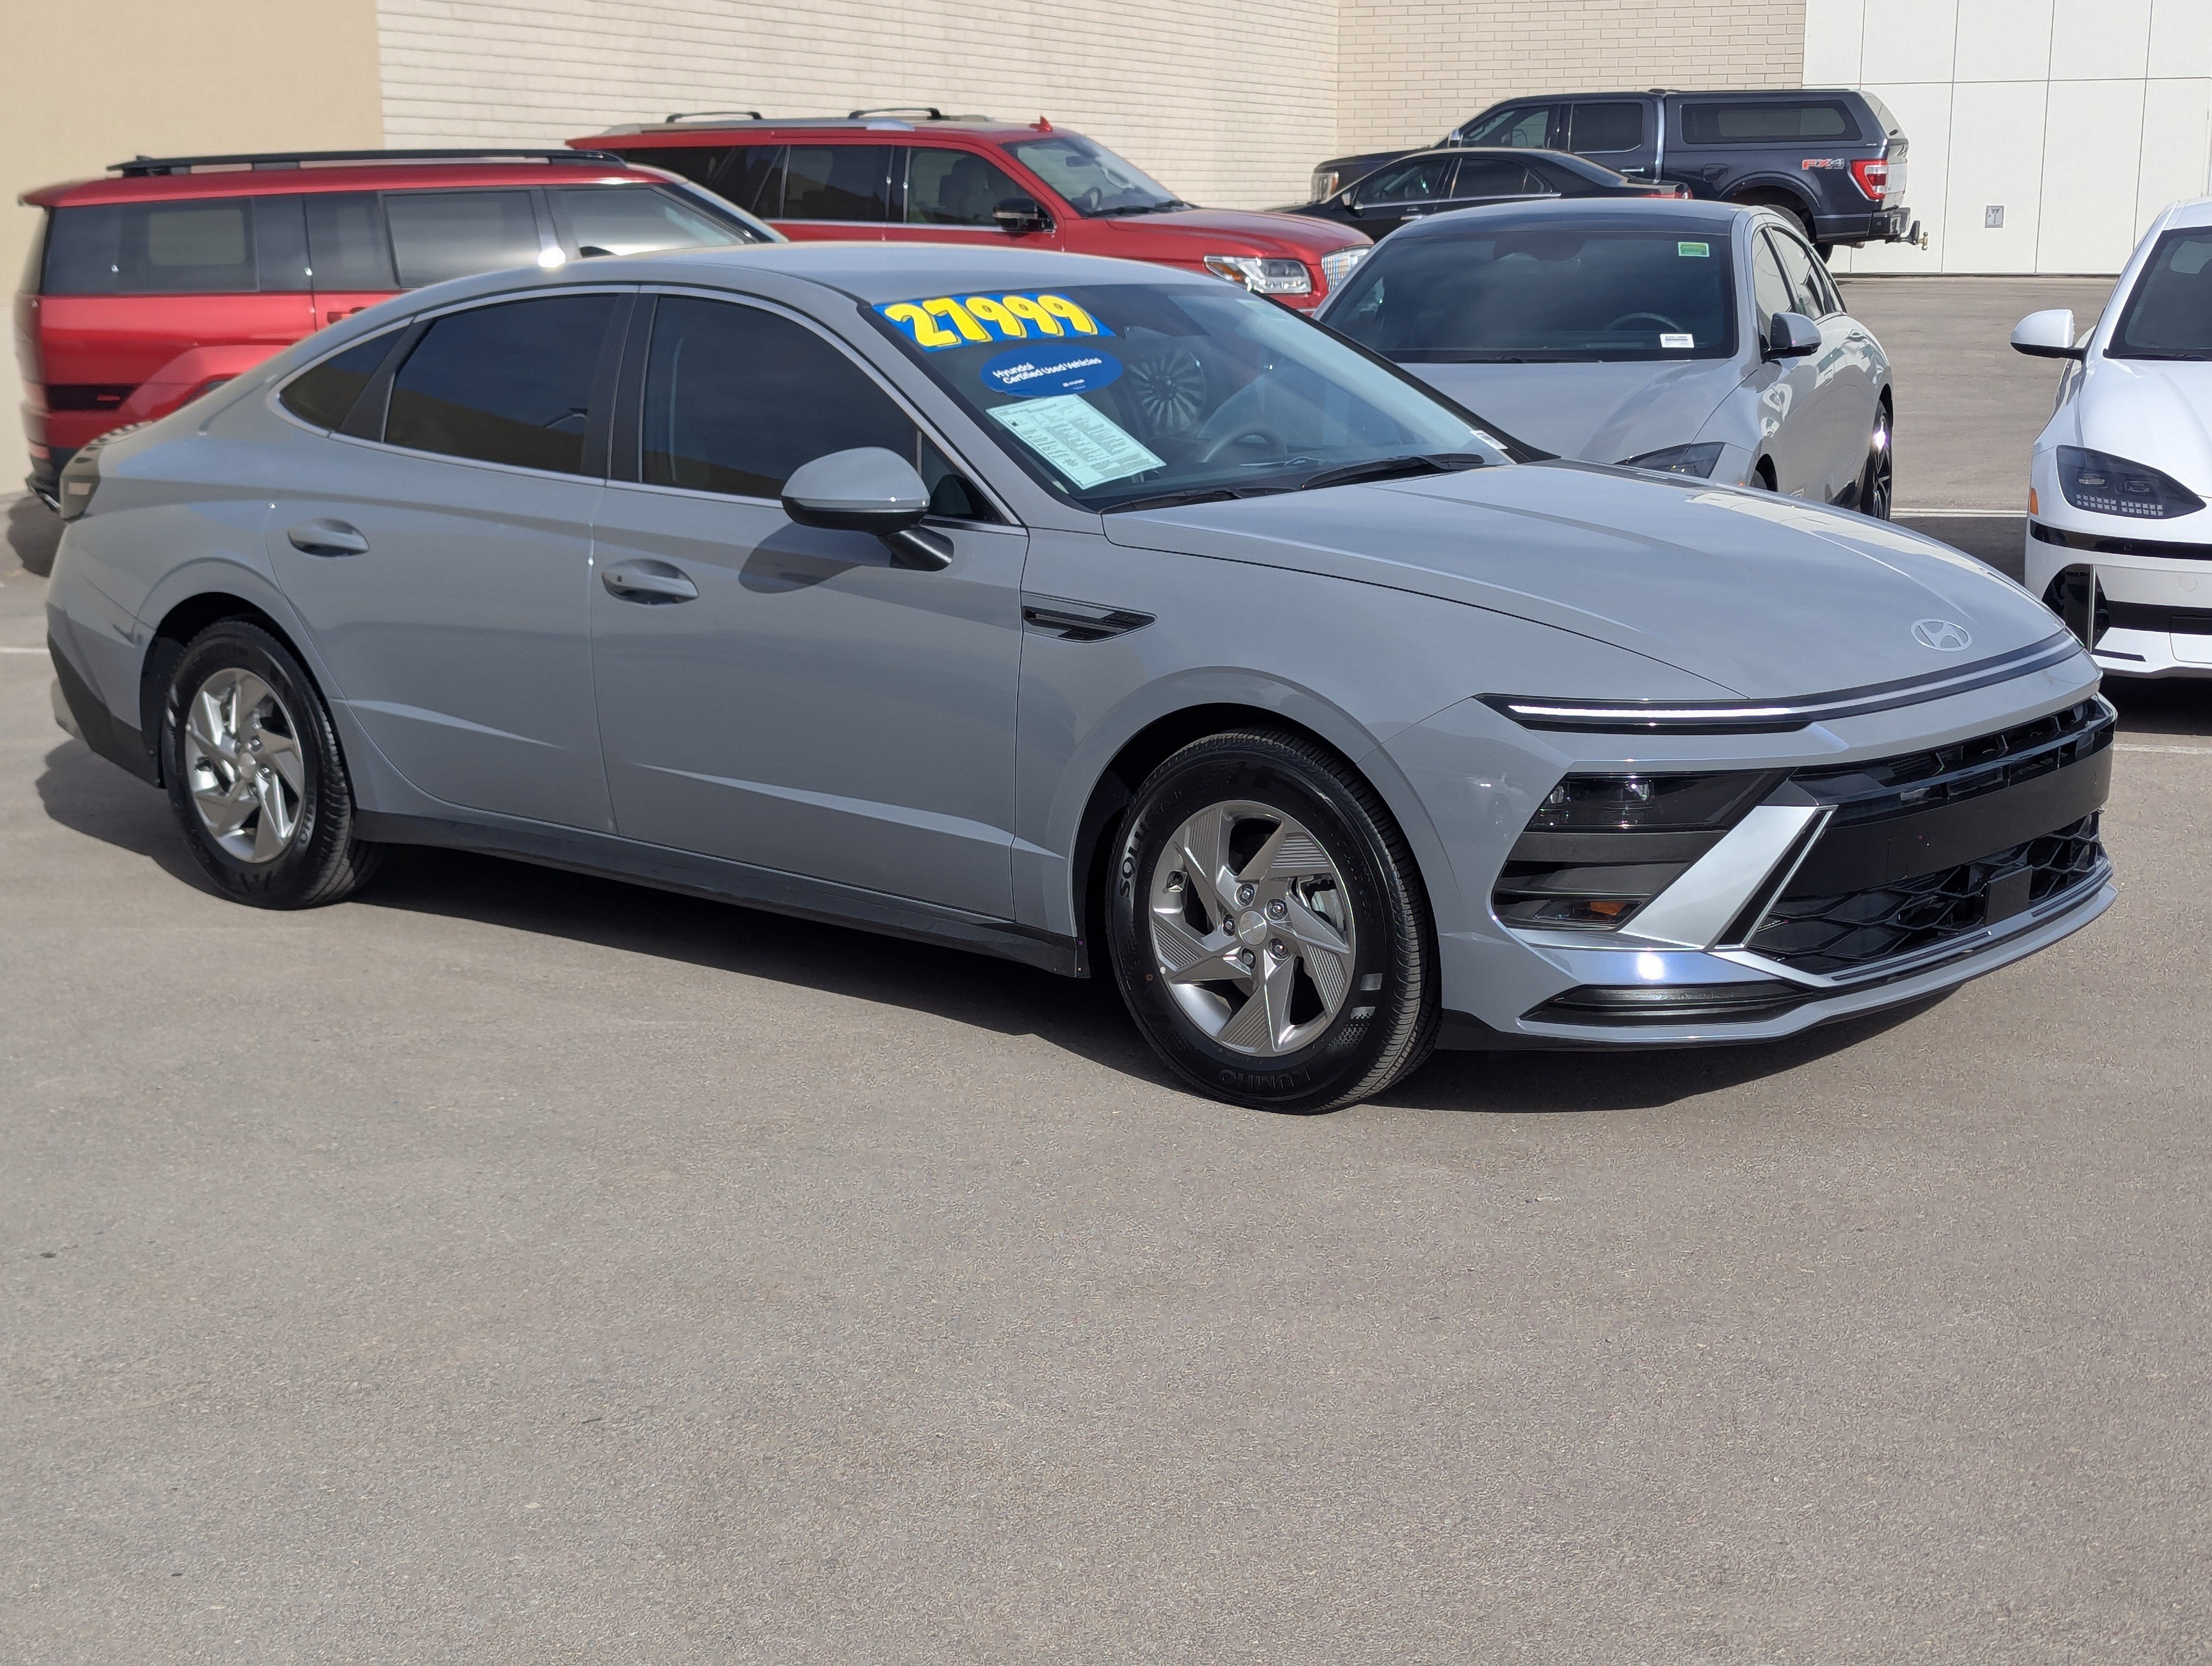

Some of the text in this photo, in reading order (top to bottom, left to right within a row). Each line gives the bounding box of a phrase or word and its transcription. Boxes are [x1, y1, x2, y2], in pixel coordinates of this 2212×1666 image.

[1802, 158, 1845, 170] FX4
[884, 295, 1099, 347] 27999
[992, 362, 1035, 378] Hyundai
[1002, 357, 1103, 384] Certified Used Vehicles
